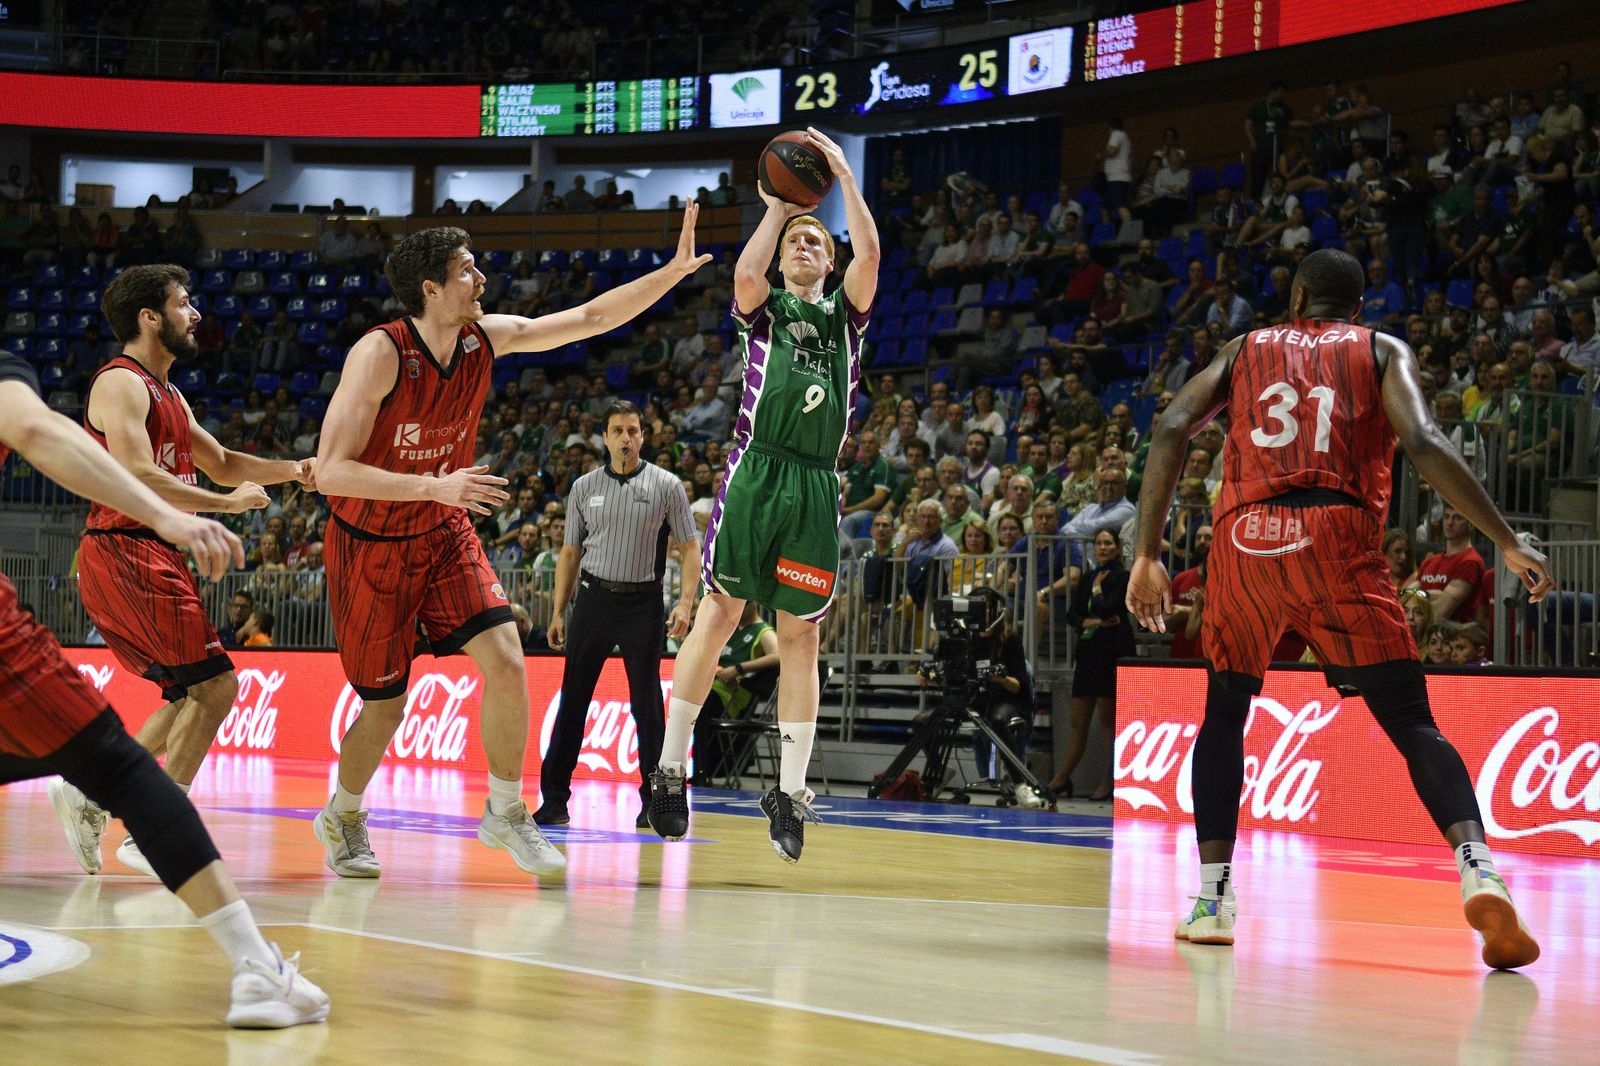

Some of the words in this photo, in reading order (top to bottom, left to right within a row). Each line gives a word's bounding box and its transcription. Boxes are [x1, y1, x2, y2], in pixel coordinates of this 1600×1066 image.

[1098, 14, 1135, 32] BELLAS
[1097, 26, 1138, 43] POPOVIC
[1097, 39, 1135, 55] EYENGA
[959, 50, 998, 91] 25
[1096, 60, 1146, 80] GONZALEZ
[595, 81, 615, 92] PTS
[795, 72, 837, 111] 23
[881, 84, 931, 101] endesa
[595, 92, 615, 103] PTS
[595, 103, 615, 113] PTS
[730, 109, 764, 120] Unicaja
[595, 113, 615, 124] PTS
[497, 126, 546, 137] LESSORT
[595, 124, 615, 134] PTS
[1255, 329, 1358, 349] EYENGA
[802, 384, 826, 414] 9
[1250, 381, 1336, 453] 31
[776, 564, 827, 590] worten
